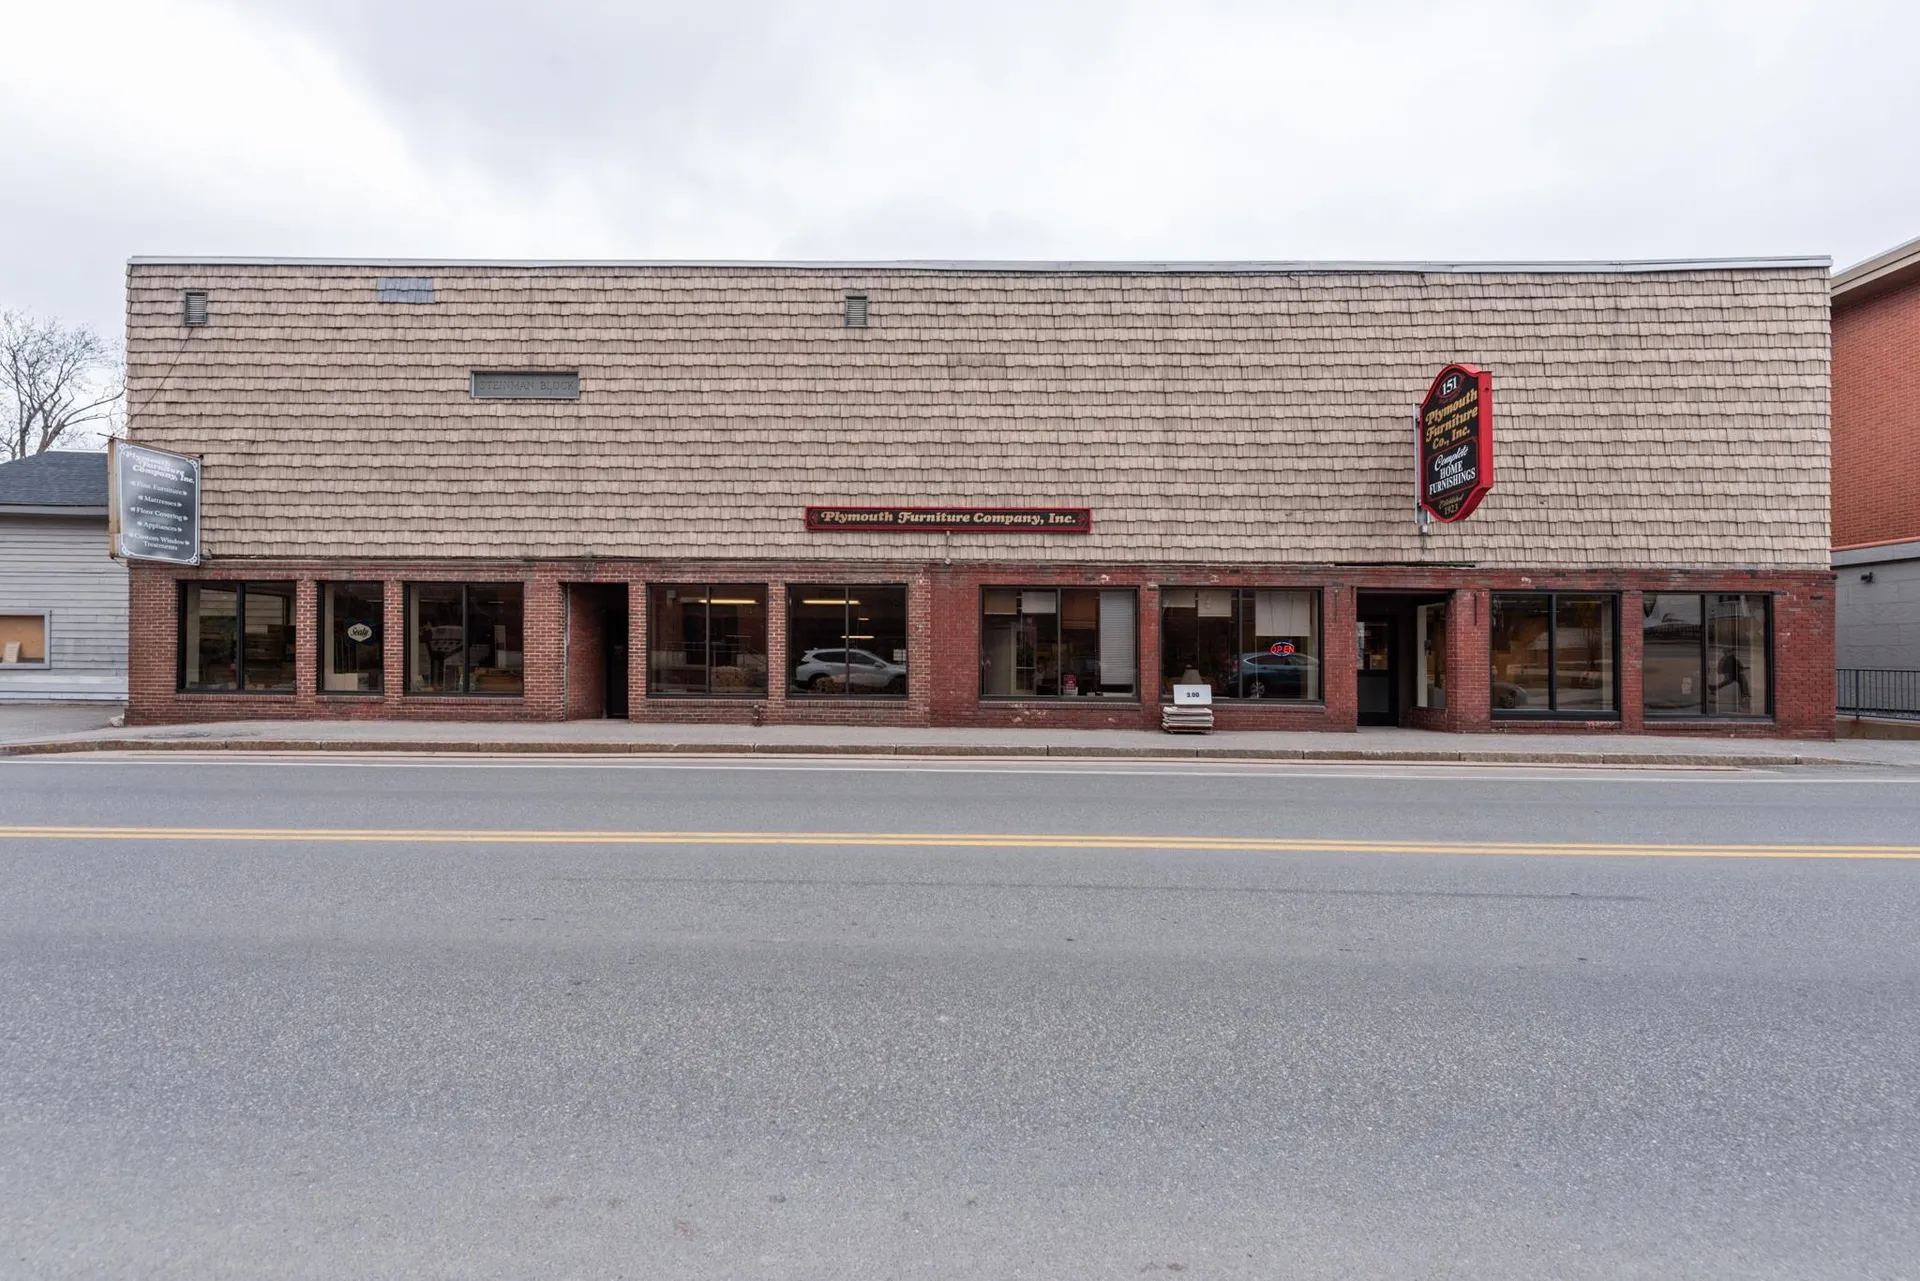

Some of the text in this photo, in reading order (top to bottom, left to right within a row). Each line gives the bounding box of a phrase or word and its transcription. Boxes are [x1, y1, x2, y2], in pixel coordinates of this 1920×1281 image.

[540, 380, 574, 391] BLOCK
[1442, 376, 1457, 396] 151
[1425, 388, 1478, 425] Plymouth
[1426, 405, 1479, 443] Furniture
[1432, 425, 1471, 450] Co., Inc.
[122, 450, 171, 466] Plymouth
[1434, 445, 1469, 471] Complete
[132, 464, 195, 484] Company, Inc.
[138, 461, 185, 475] Furniture
[1440, 460, 1464, 480] HOME
[1429, 467, 1476, 496] FURNISHINGS
[153, 483, 184, 496] Furniture
[143, 495, 177, 507] Mattresses
[136, 507, 183, 522] Floor Covering
[1444, 502, 1459, 516] 1923
[820, 510, 1077, 526] Plymouth Furniture Company, Inc.
[143, 521, 177, 532] Appliances
[134, 533, 185, 545] Custom Window
[143, 541, 178, 551] Treatments
[1271, 645, 1295, 653] OPEN
